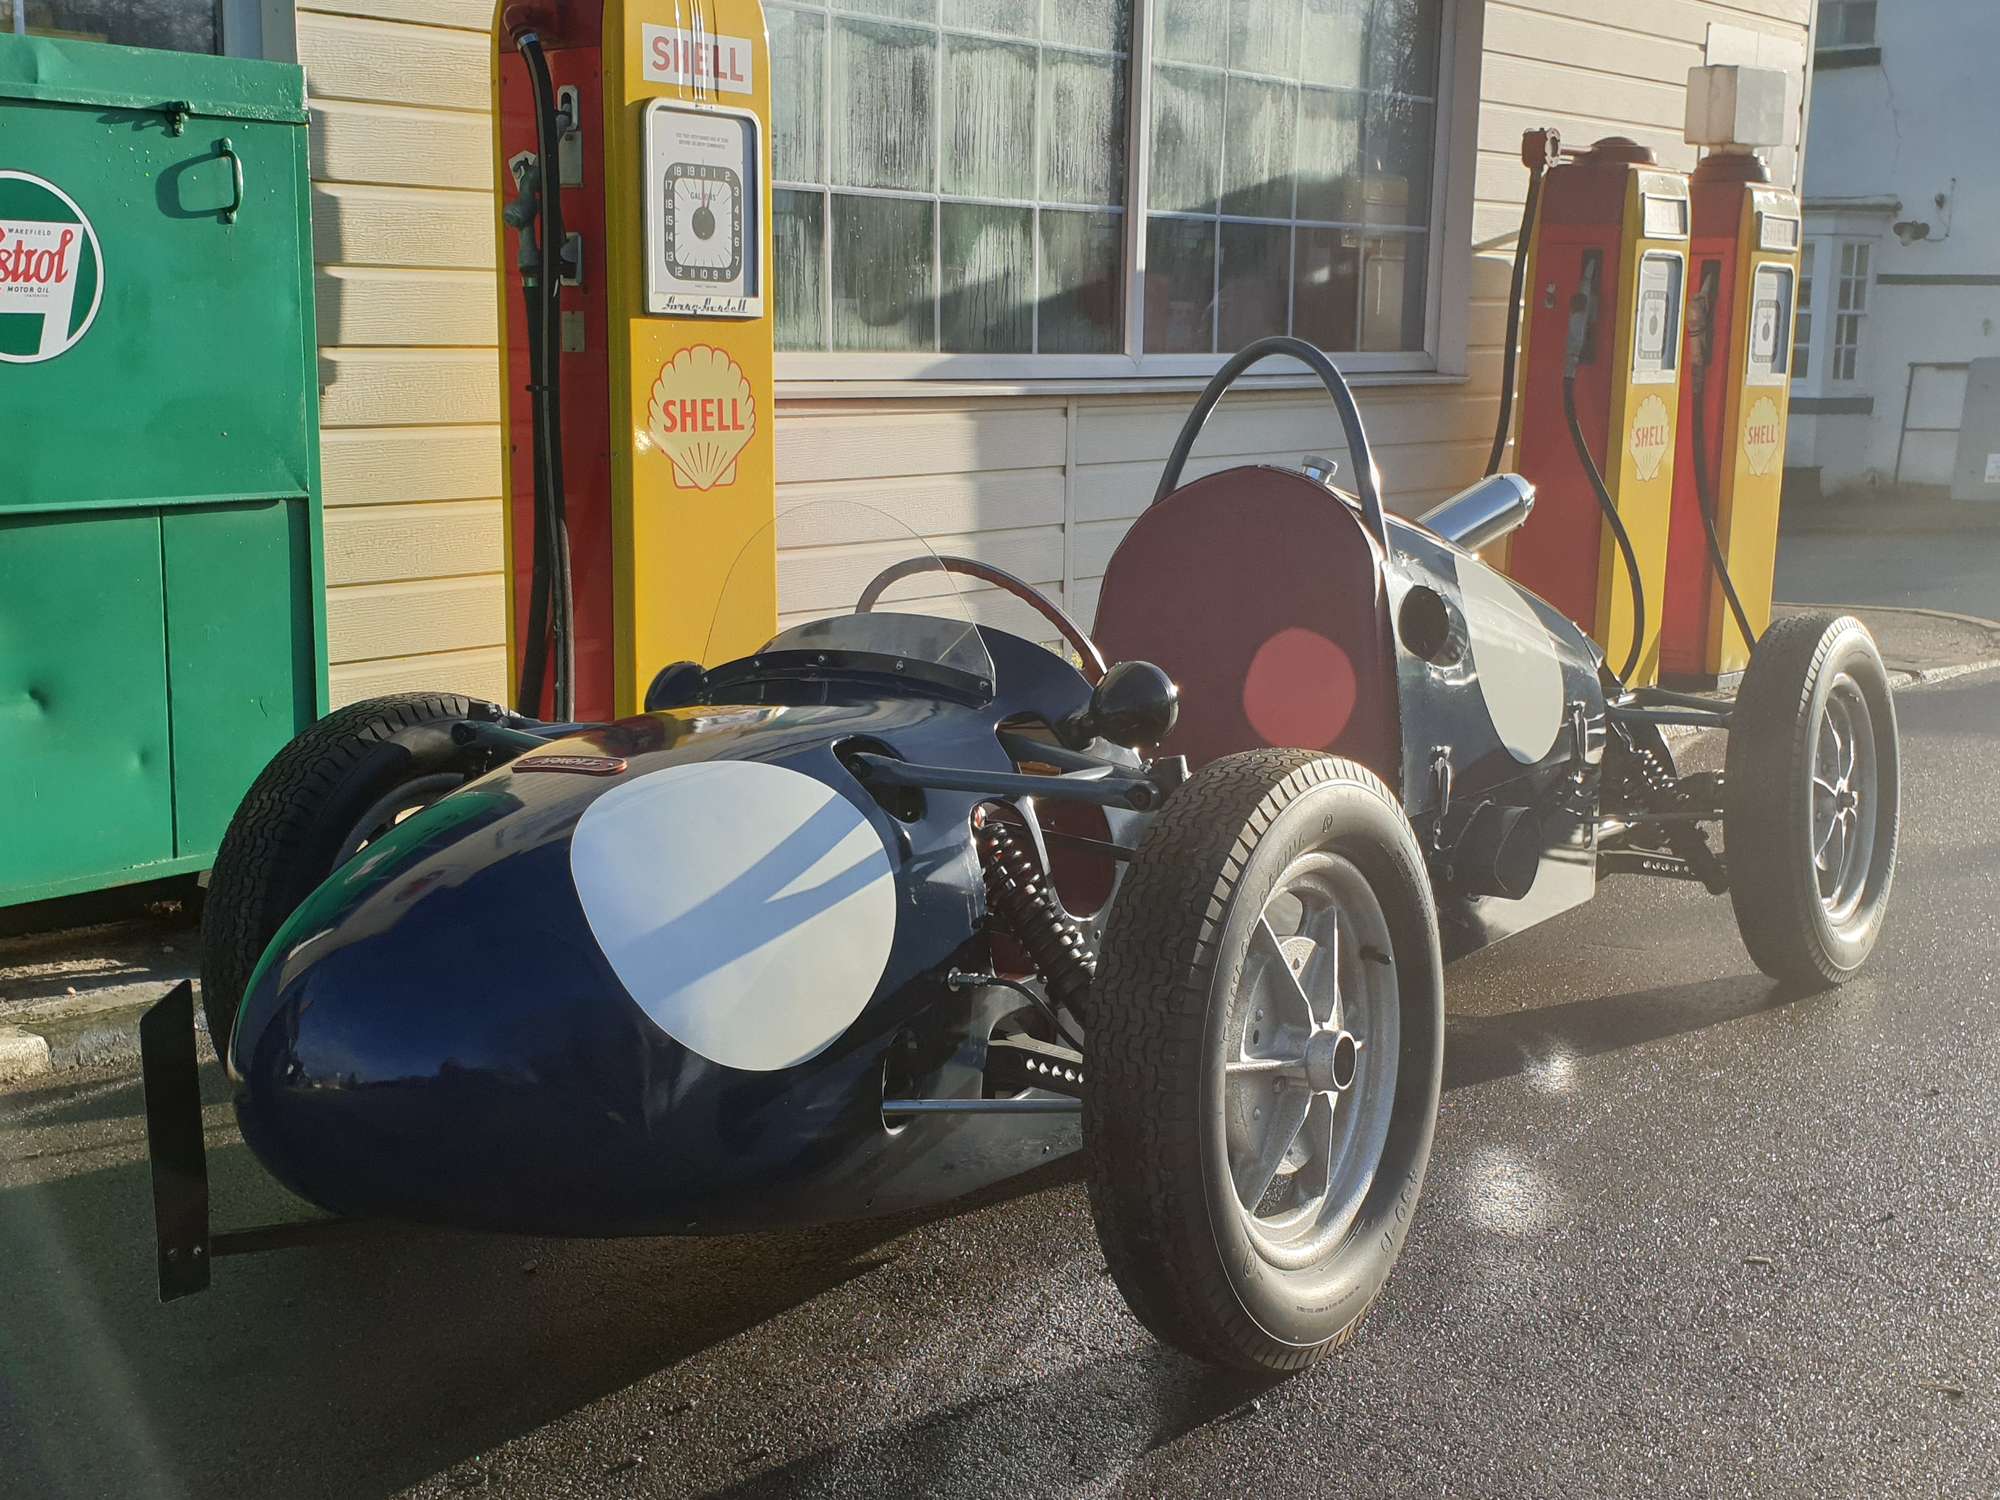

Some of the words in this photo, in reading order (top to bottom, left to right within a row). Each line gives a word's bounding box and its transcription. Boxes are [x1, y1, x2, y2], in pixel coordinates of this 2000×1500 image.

[652, 36, 744, 82] SHELL
[673, 166, 682, 176] 18
[687, 166, 695, 177] 19
[700, 167, 706, 177] 0
[724, 171, 731, 181] 2
[665, 180, 673, 190] 17
[733, 186, 740, 197] 3
[734, 204, 740, 214] 4
[665, 215, 673, 226] 15
[734, 220, 740, 231] 5
[7, 228, 52, 237] WAKEFIELD
[665, 231, 673, 242] 14
[734, 237, 740, 247] 6
[0, 226, 74, 283] strol
[665, 251, 674, 262] 13
[734, 255, 740, 266] 7
[674, 266, 683, 277] 12
[700, 267, 708, 279] 10
[712, 270, 719, 280] 9
[725, 269, 731, 279] 8
[7, 286, 35, 294] MOTOR
[662, 398, 745, 433] SHELL
[1635, 425, 1664, 448] SHELL
[1747, 424, 1776, 446] SHELL
